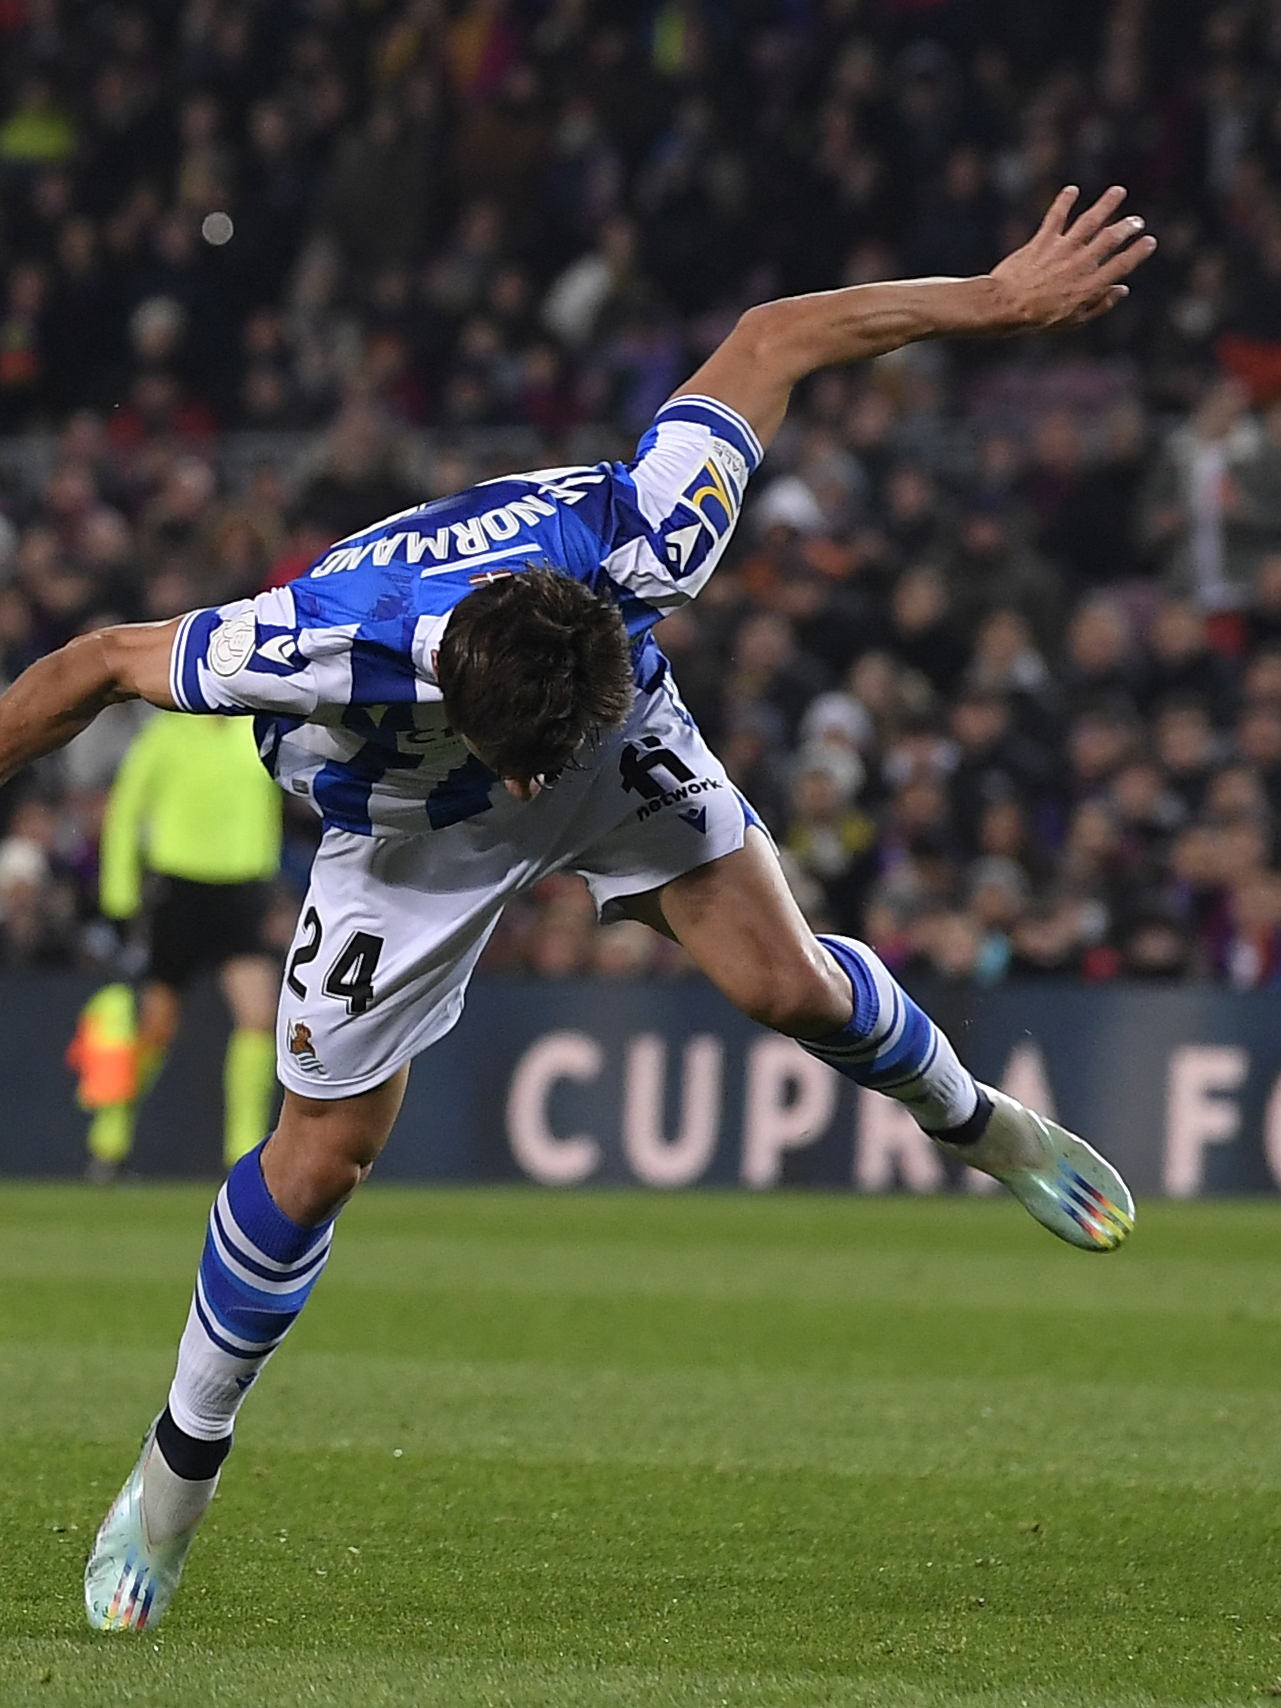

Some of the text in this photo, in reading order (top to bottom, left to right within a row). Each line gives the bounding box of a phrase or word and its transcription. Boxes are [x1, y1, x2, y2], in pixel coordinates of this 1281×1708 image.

[309, 493, 558, 579] NORMAND
[635, 777, 724, 822] network
[286, 905, 385, 1016] 24
[1165, 1043, 1281, 1198] F
